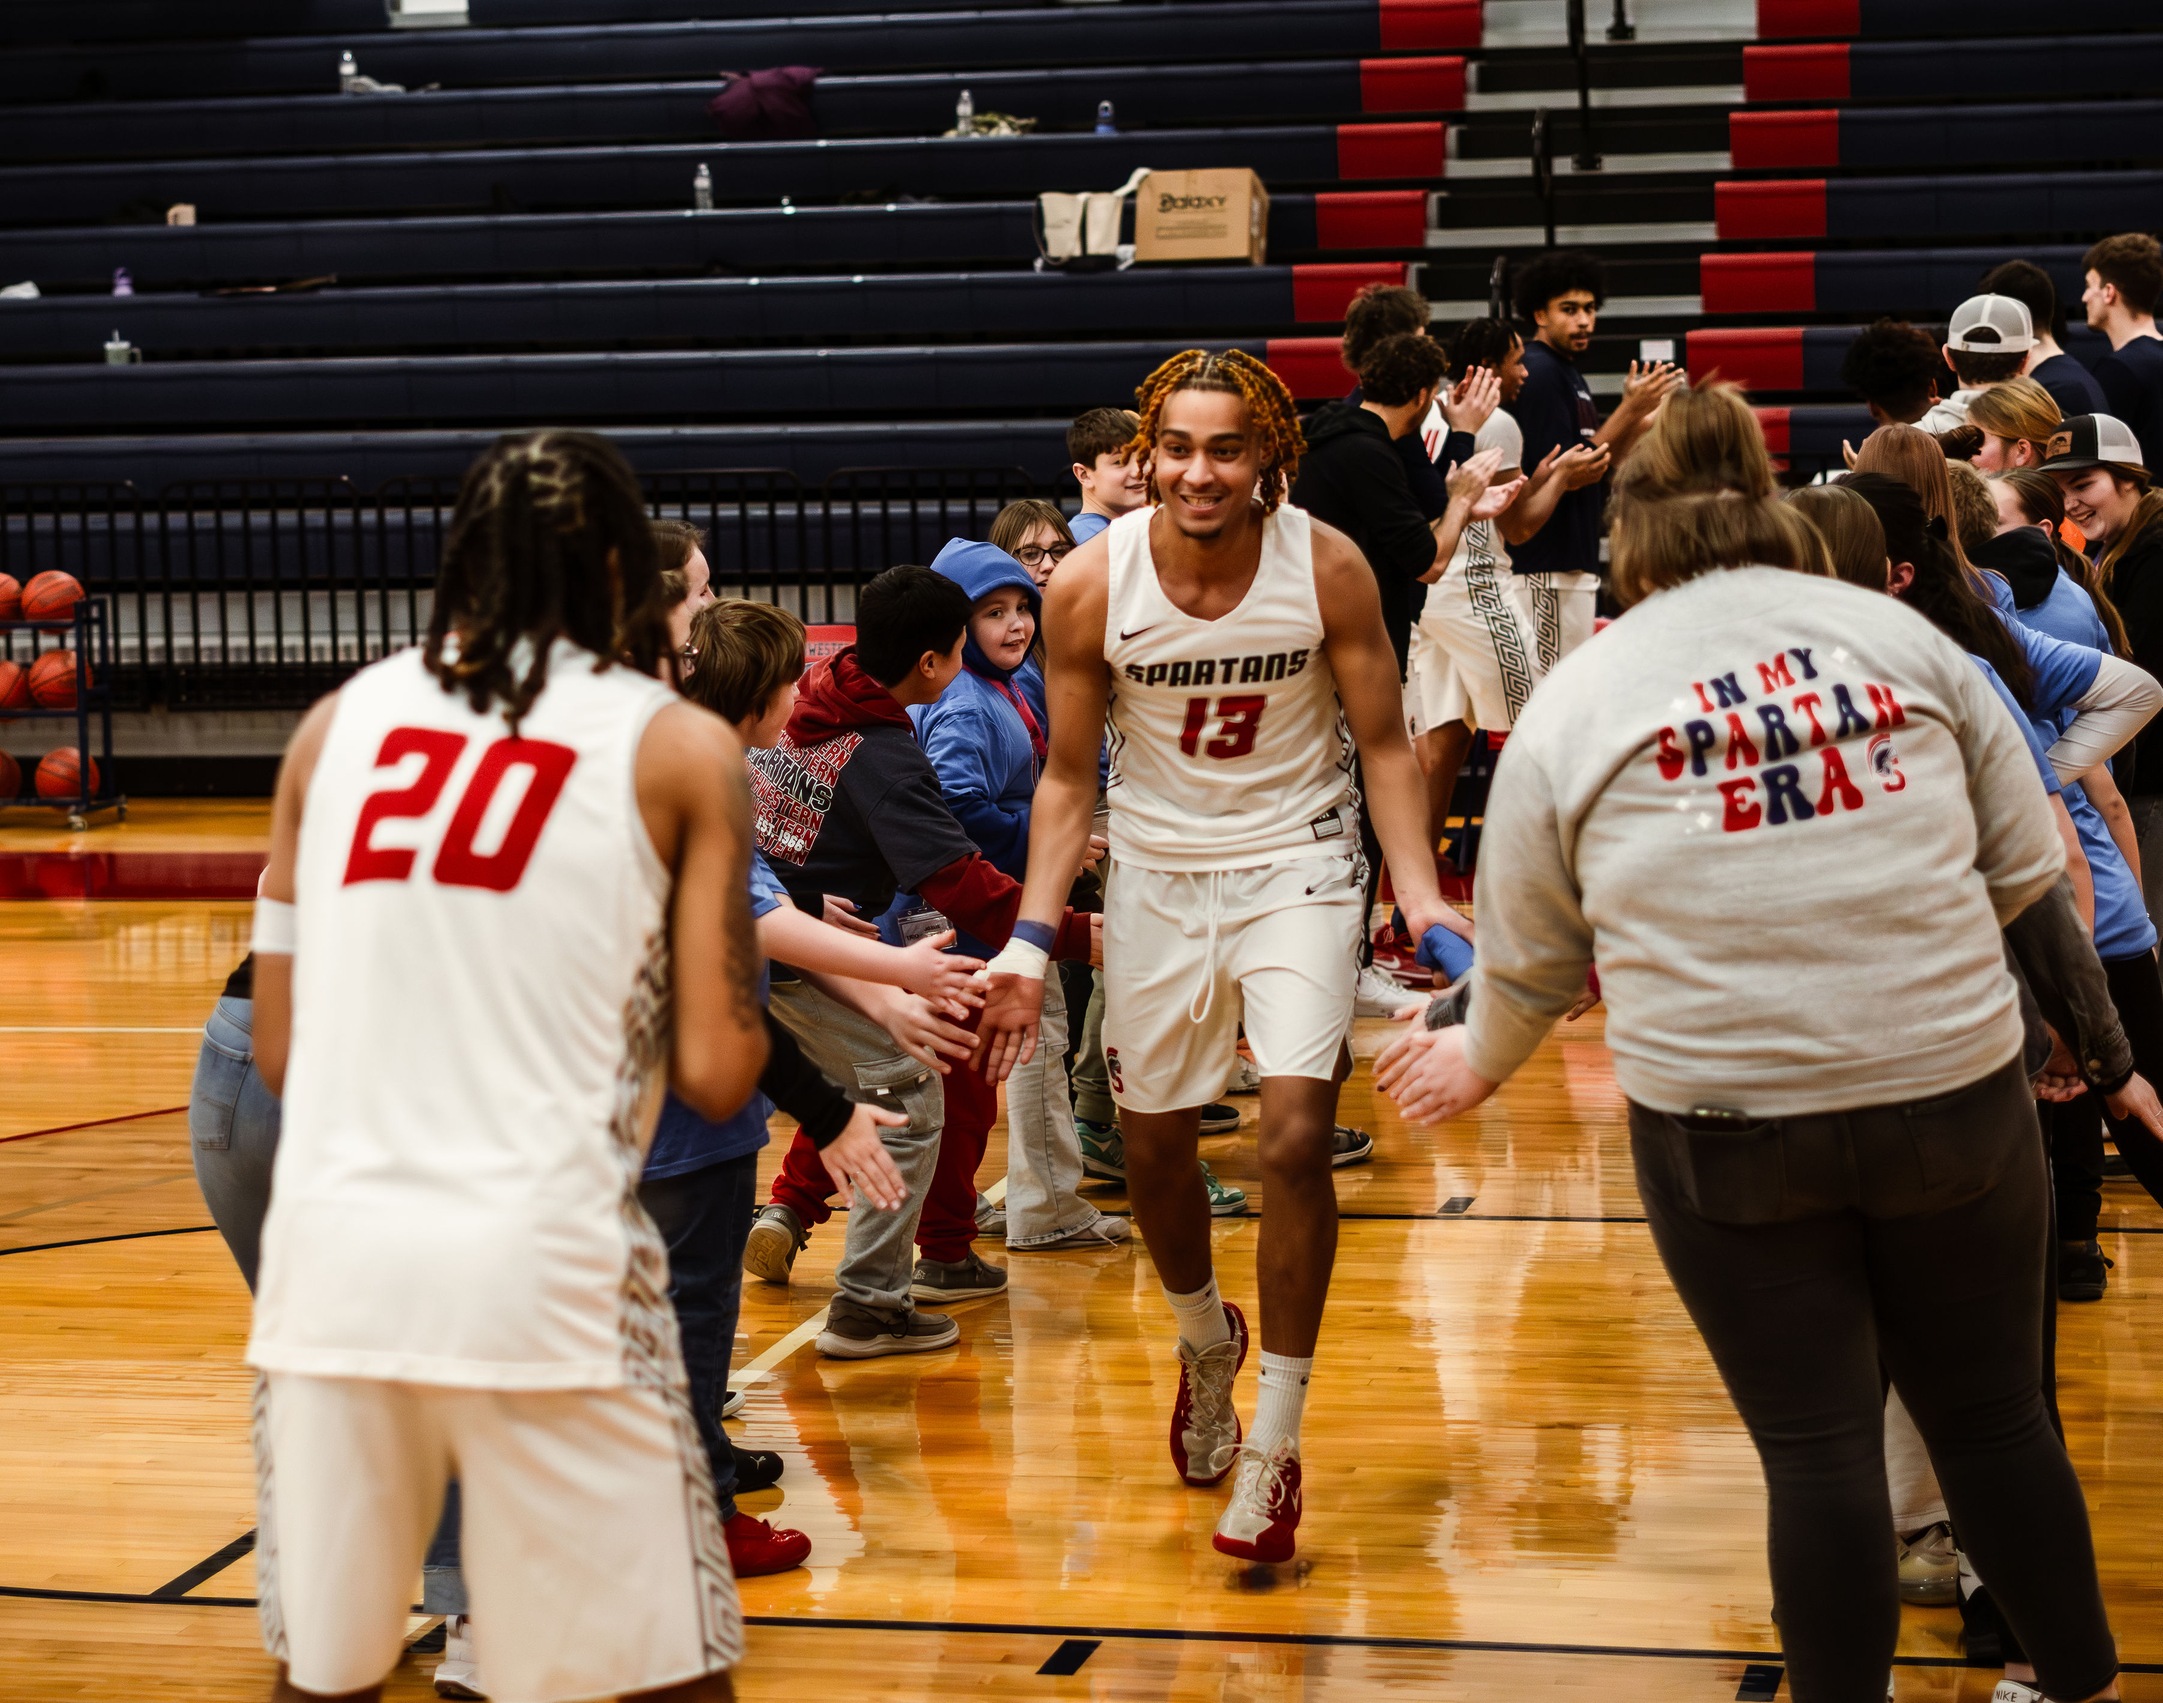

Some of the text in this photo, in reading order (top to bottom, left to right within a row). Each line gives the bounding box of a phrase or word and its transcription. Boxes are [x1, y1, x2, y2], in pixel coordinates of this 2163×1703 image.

[1125, 649, 1310, 687] SPARTANS
[1692, 648, 1818, 713] IN MY
[1179, 694, 1268, 761] 13
[1656, 683, 1906, 781] SPARTAN
[341, 726, 578, 893] 20
[1717, 746, 1864, 833] ERA
[778, 829, 805, 852] 1966
[1995, 1689, 2018, 1702] NIKE
